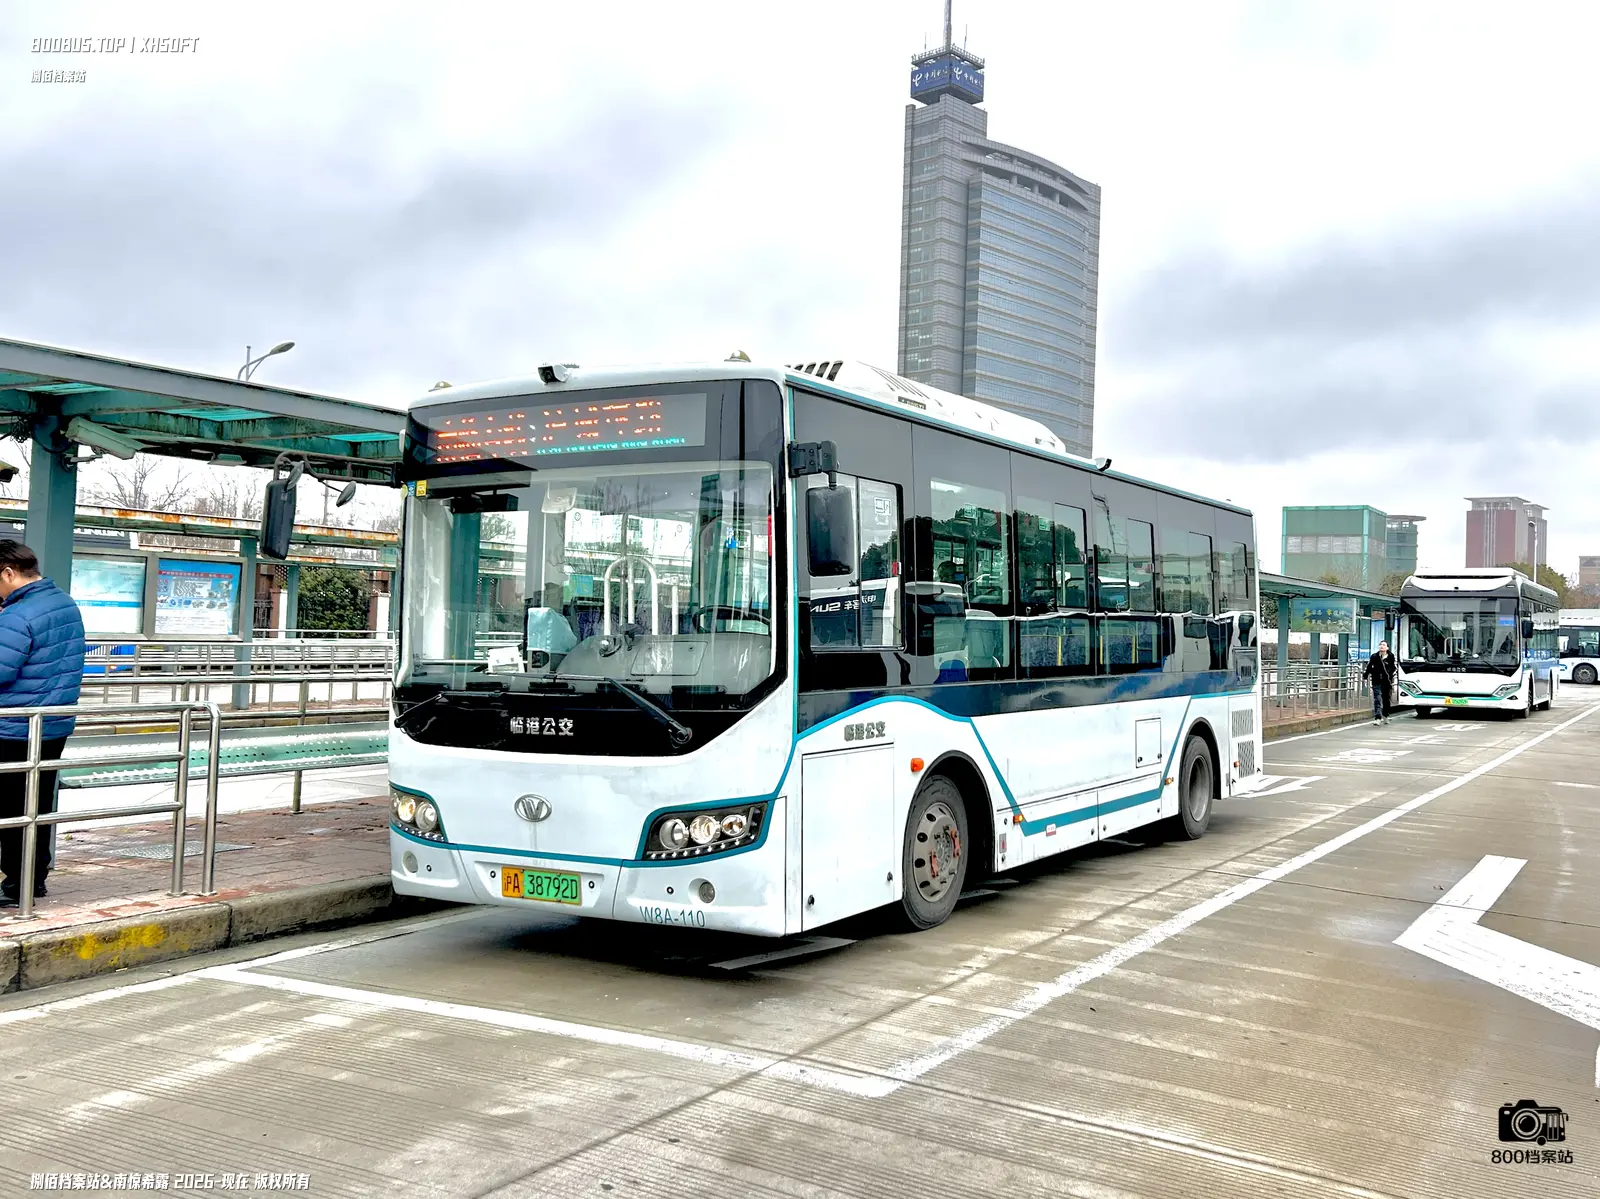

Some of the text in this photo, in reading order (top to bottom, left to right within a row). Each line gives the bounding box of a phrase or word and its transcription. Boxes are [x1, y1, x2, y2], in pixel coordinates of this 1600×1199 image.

[510, 716, 574, 736] 临港公交
[844, 721, 886, 742] 临港公交
[504, 872, 578, 900] 沪A 38792D
[640, 905, 706, 928] W8A-110
